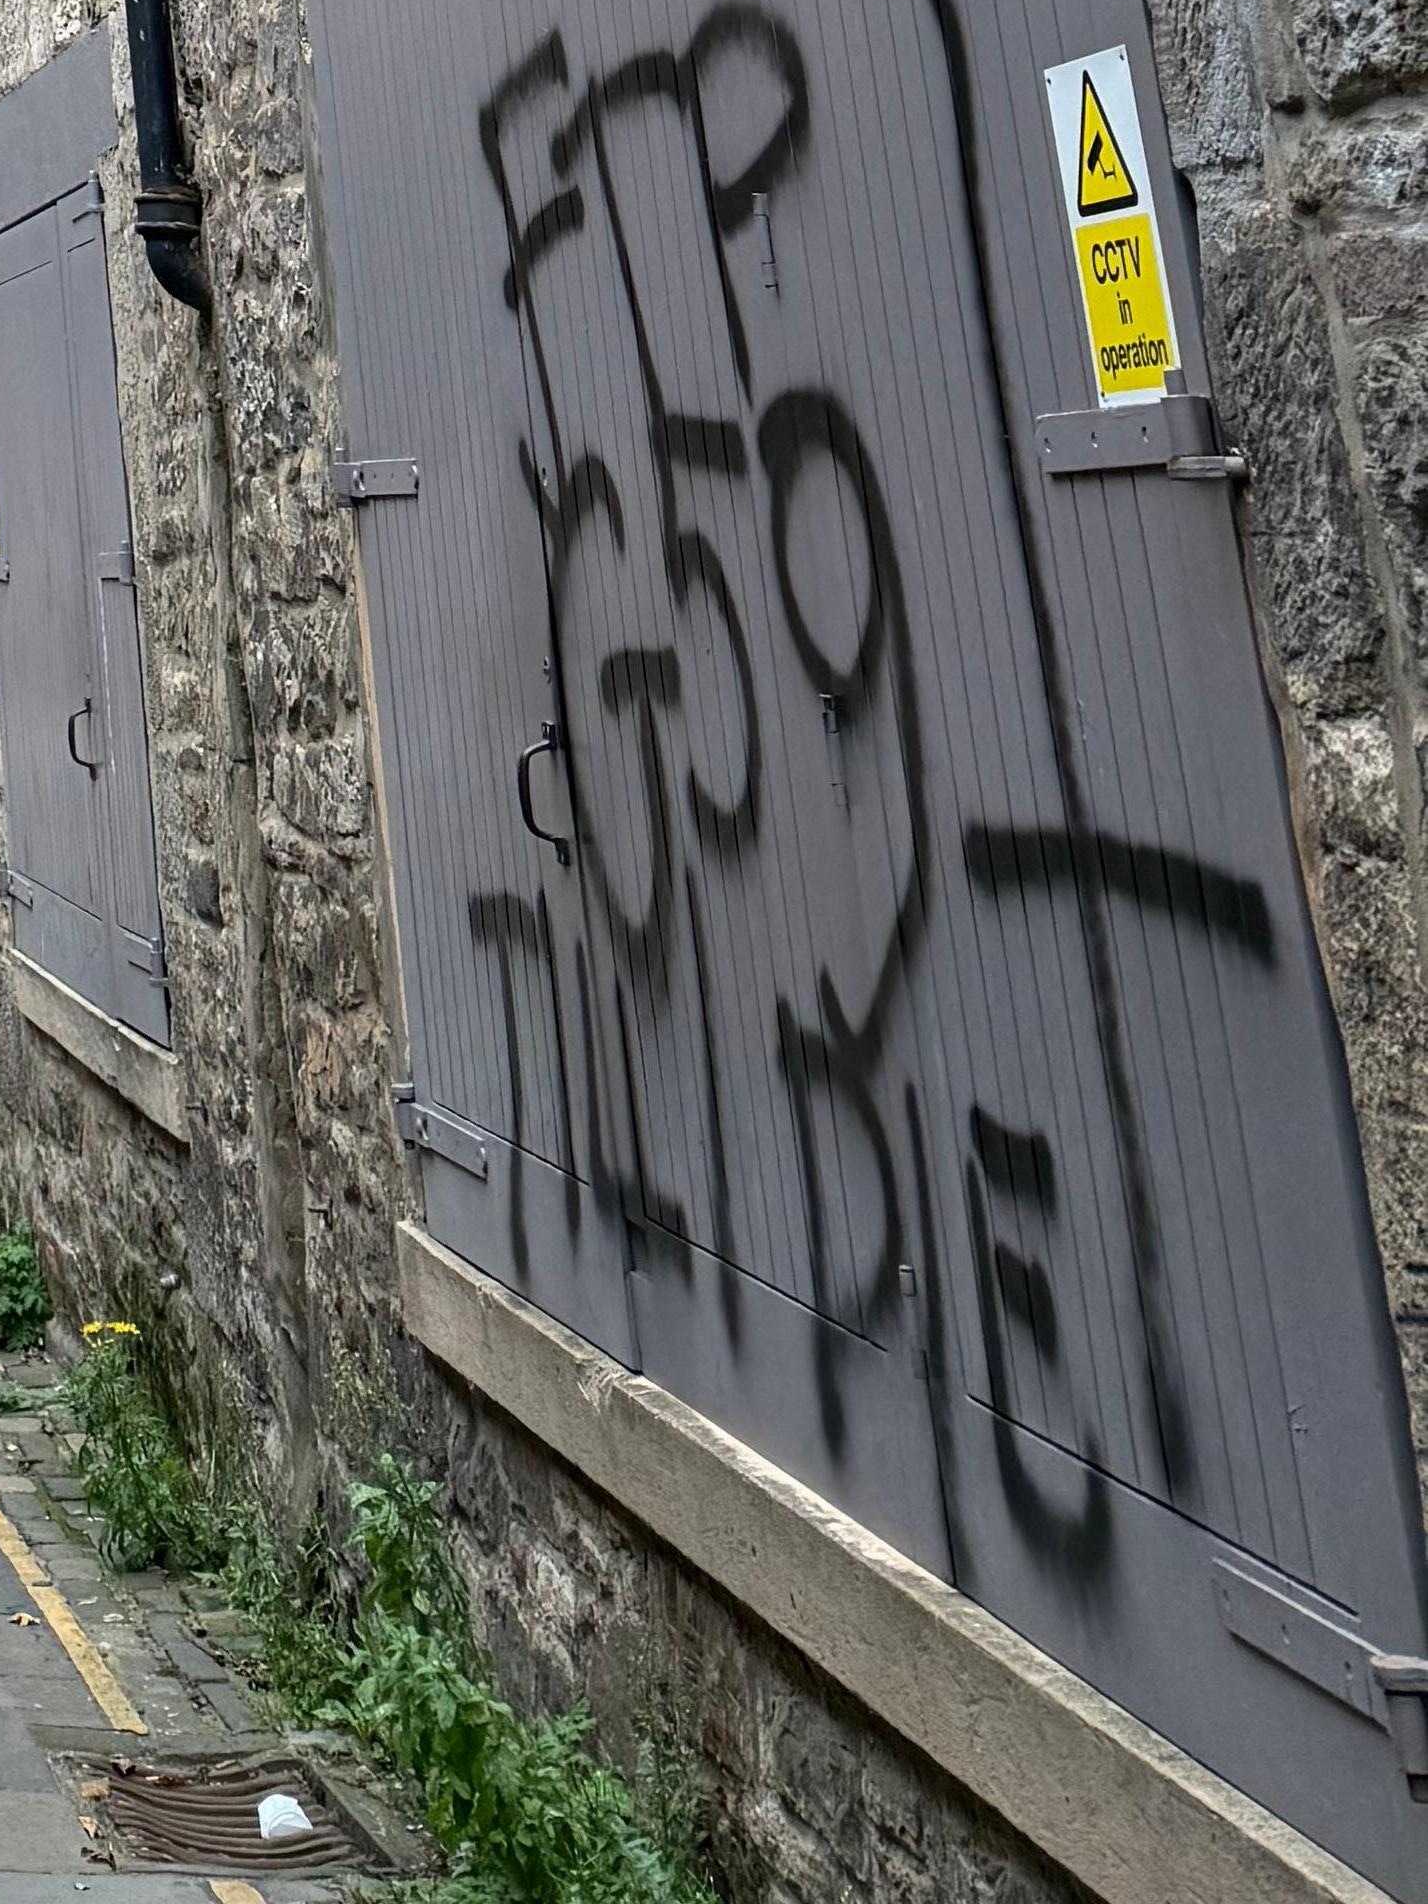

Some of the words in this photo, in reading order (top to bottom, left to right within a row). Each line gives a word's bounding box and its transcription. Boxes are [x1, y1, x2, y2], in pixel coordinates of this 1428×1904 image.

[1091, 235, 1141, 285] CCTV
[1117, 292, 1133, 325] in
[1100, 334, 1170, 379] operation
